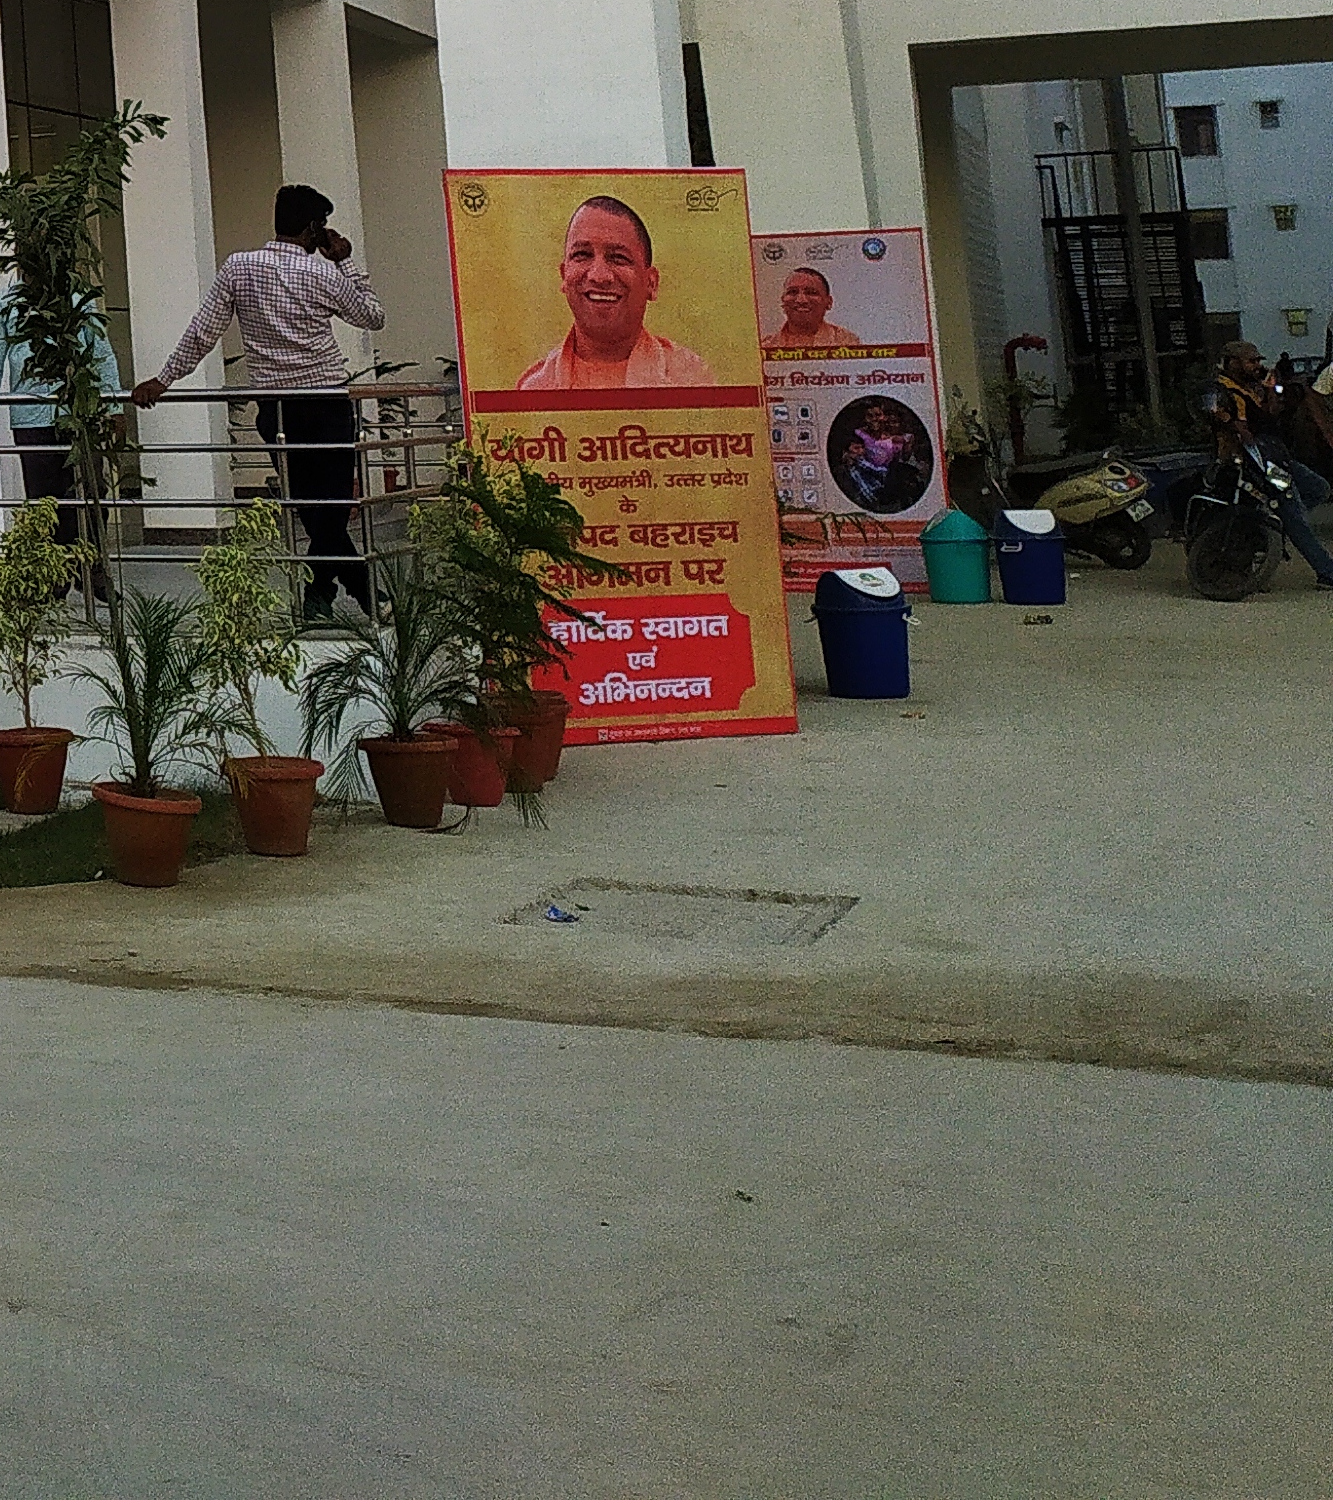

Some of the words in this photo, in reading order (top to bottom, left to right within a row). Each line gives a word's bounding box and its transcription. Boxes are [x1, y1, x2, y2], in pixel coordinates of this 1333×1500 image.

[790, 371, 850, 387] नियंत्रण
[855, 369, 925, 385] अभियान
[577, 424, 754, 462] आदित्यनाथ
[578, 468, 658, 497] मुख्यमंत्री,
[664, 472, 706, 488] उत्तर
[710, 468, 749, 488] प्रदेश
[618, 495, 638, 514] के
[627, 521, 739, 548] बहराइच
[680, 558, 726, 585] पर
[548, 611, 634, 647] हार्दिक
[640, 614, 730, 641] स्वागत
[627, 645, 659, 670] एवं
[579, 672, 712, 706] अभिनन्दन
